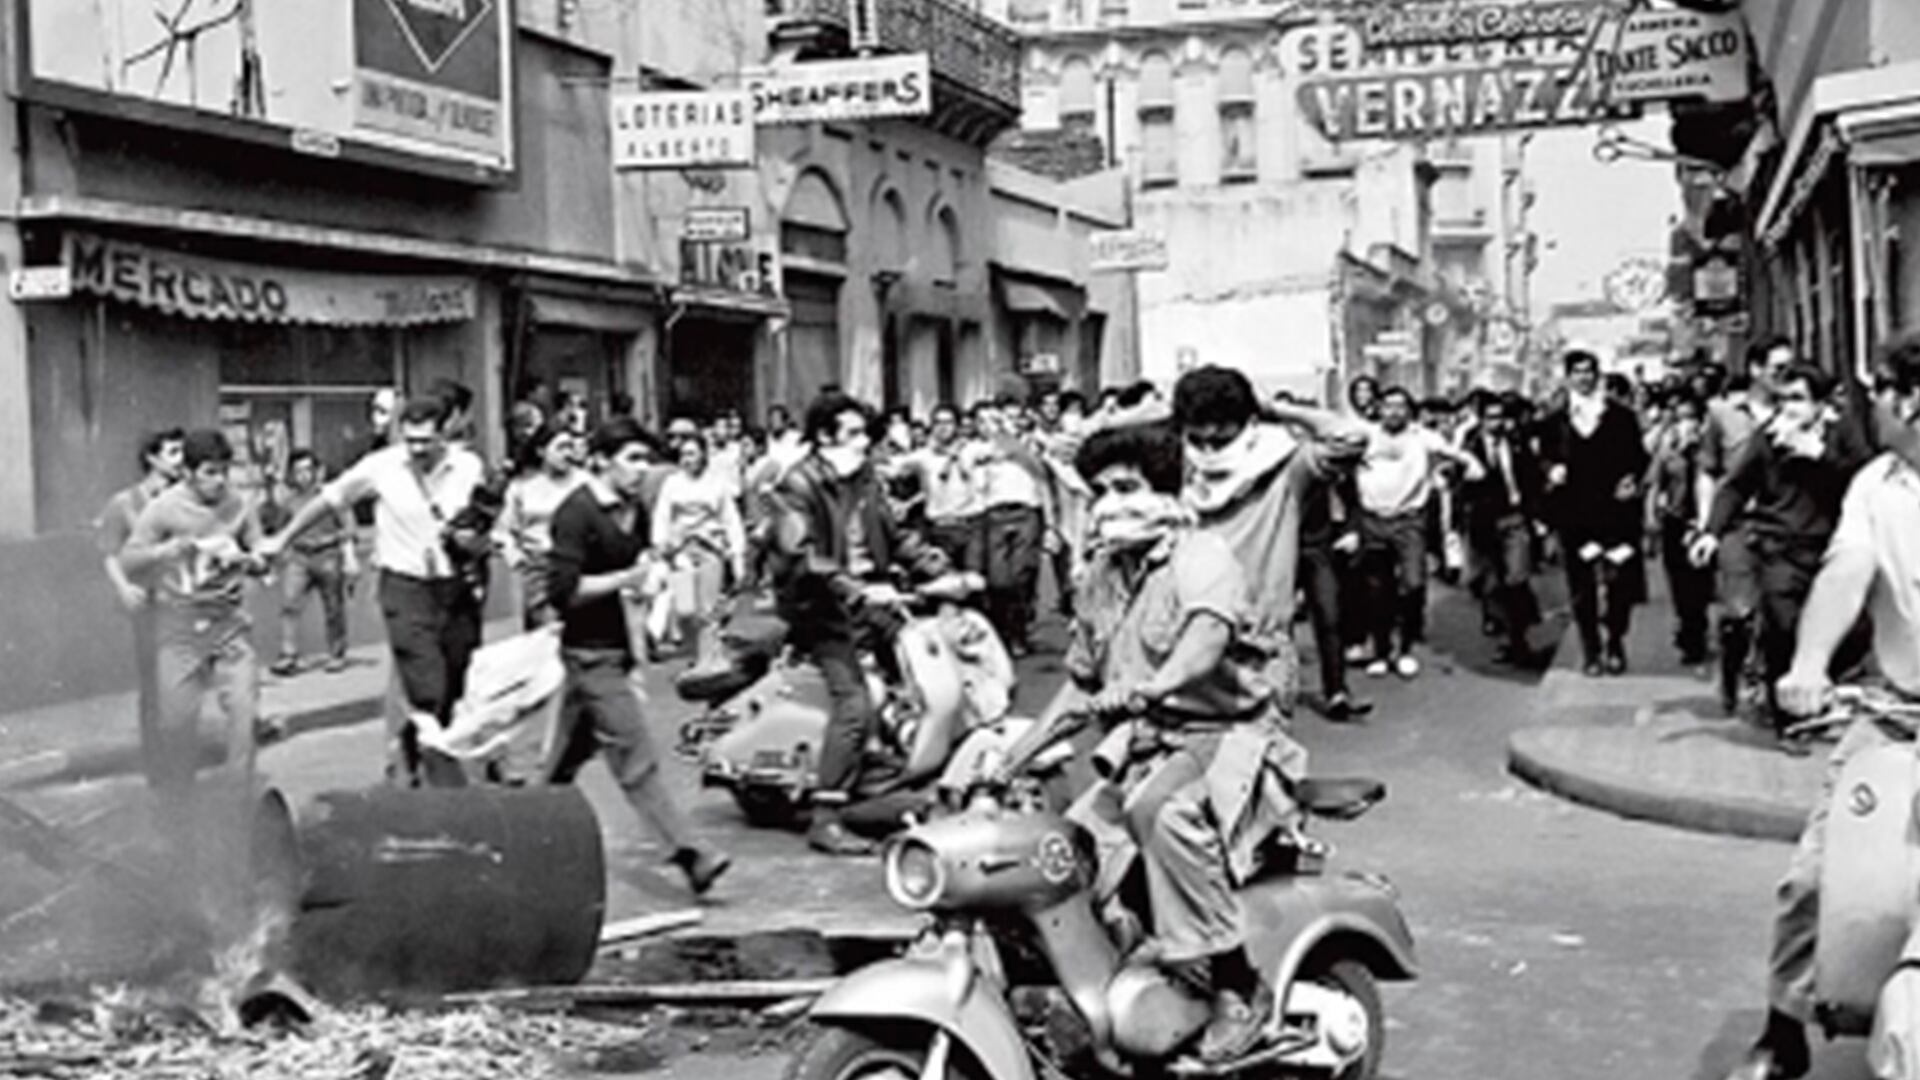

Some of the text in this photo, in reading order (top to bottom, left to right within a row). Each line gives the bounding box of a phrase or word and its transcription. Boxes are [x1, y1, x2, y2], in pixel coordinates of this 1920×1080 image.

[1665, 28, 1738, 69] SACCO
[751, 71, 922, 113] SHEAFFERS
[1314, 68, 1632, 135] VERNAZZ
[616, 100, 743, 130] LOTERIAS
[626, 136, 731, 159] ALBERTO
[72, 236, 288, 313] MERCADO
